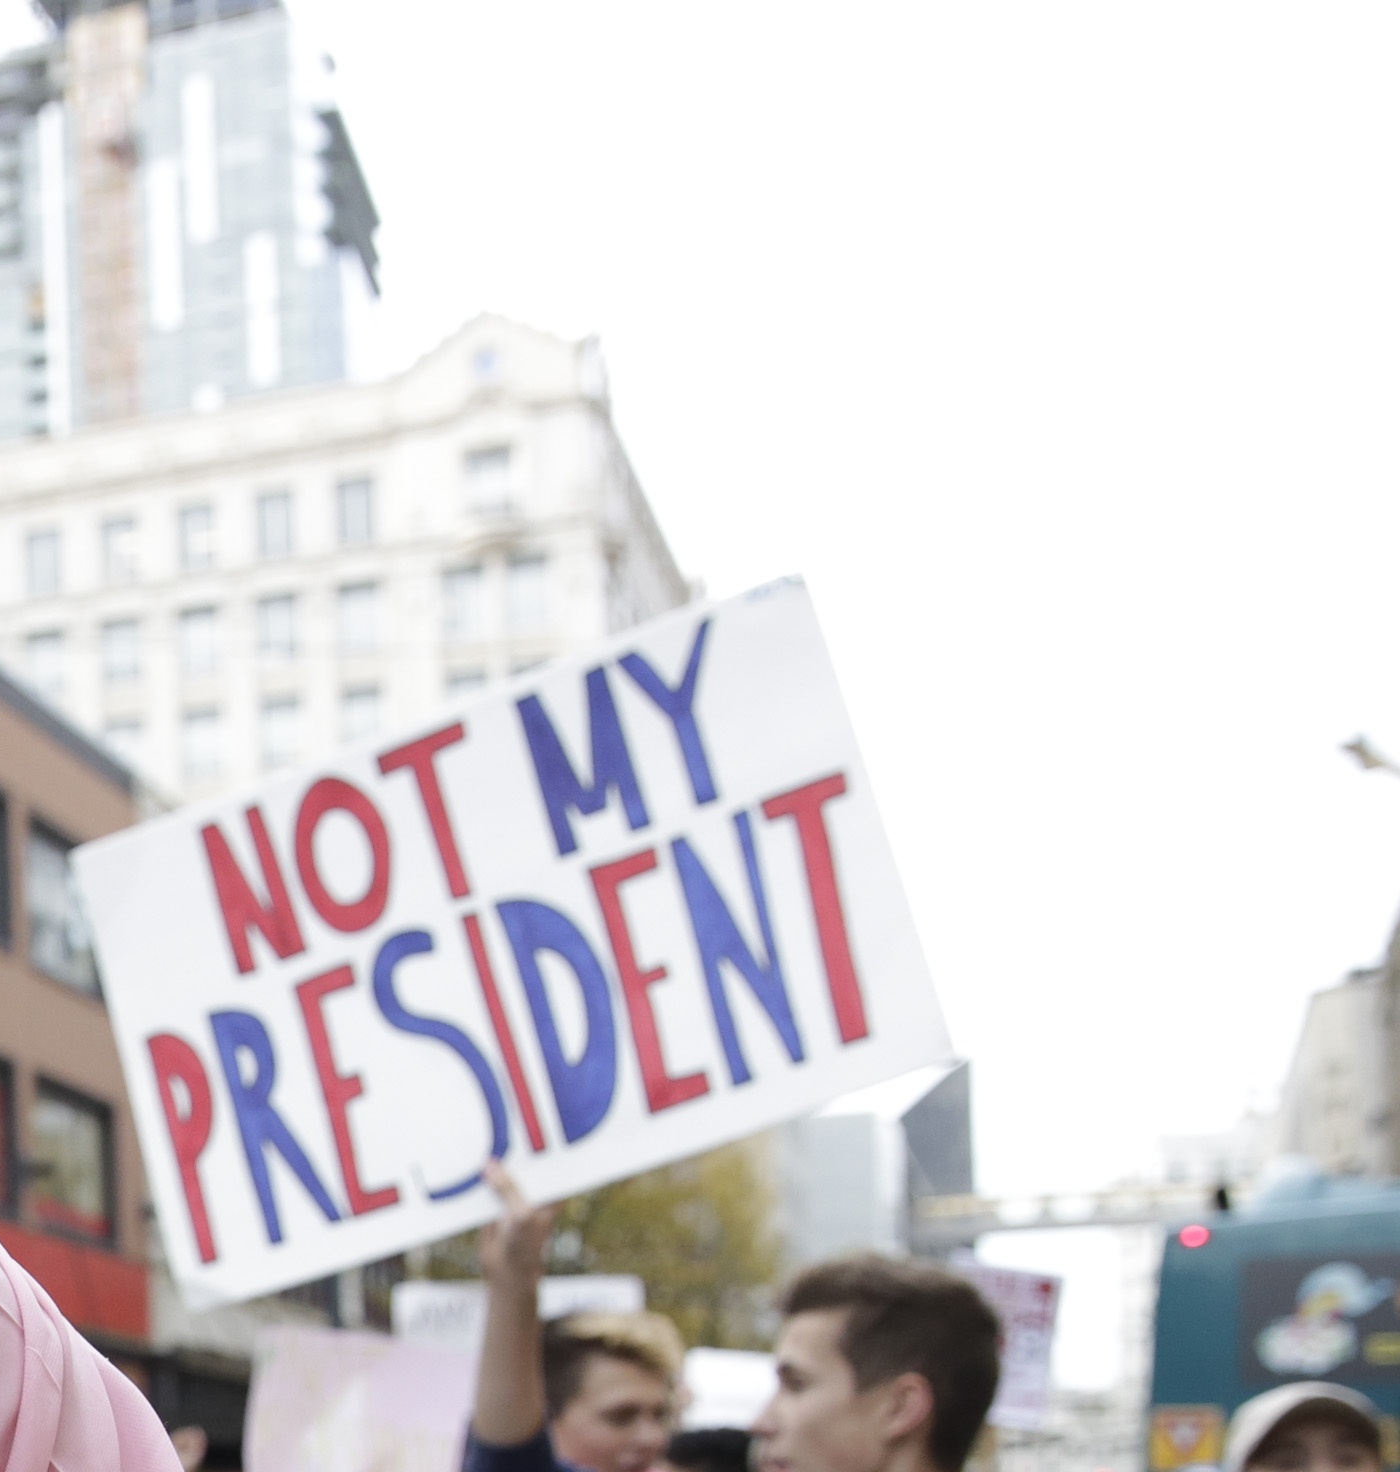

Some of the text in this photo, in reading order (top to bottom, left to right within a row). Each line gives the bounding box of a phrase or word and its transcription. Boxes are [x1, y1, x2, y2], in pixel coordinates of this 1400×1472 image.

[200, 616, 719, 976] NOT MY
[145, 772, 870, 1264] PRESIDENT
